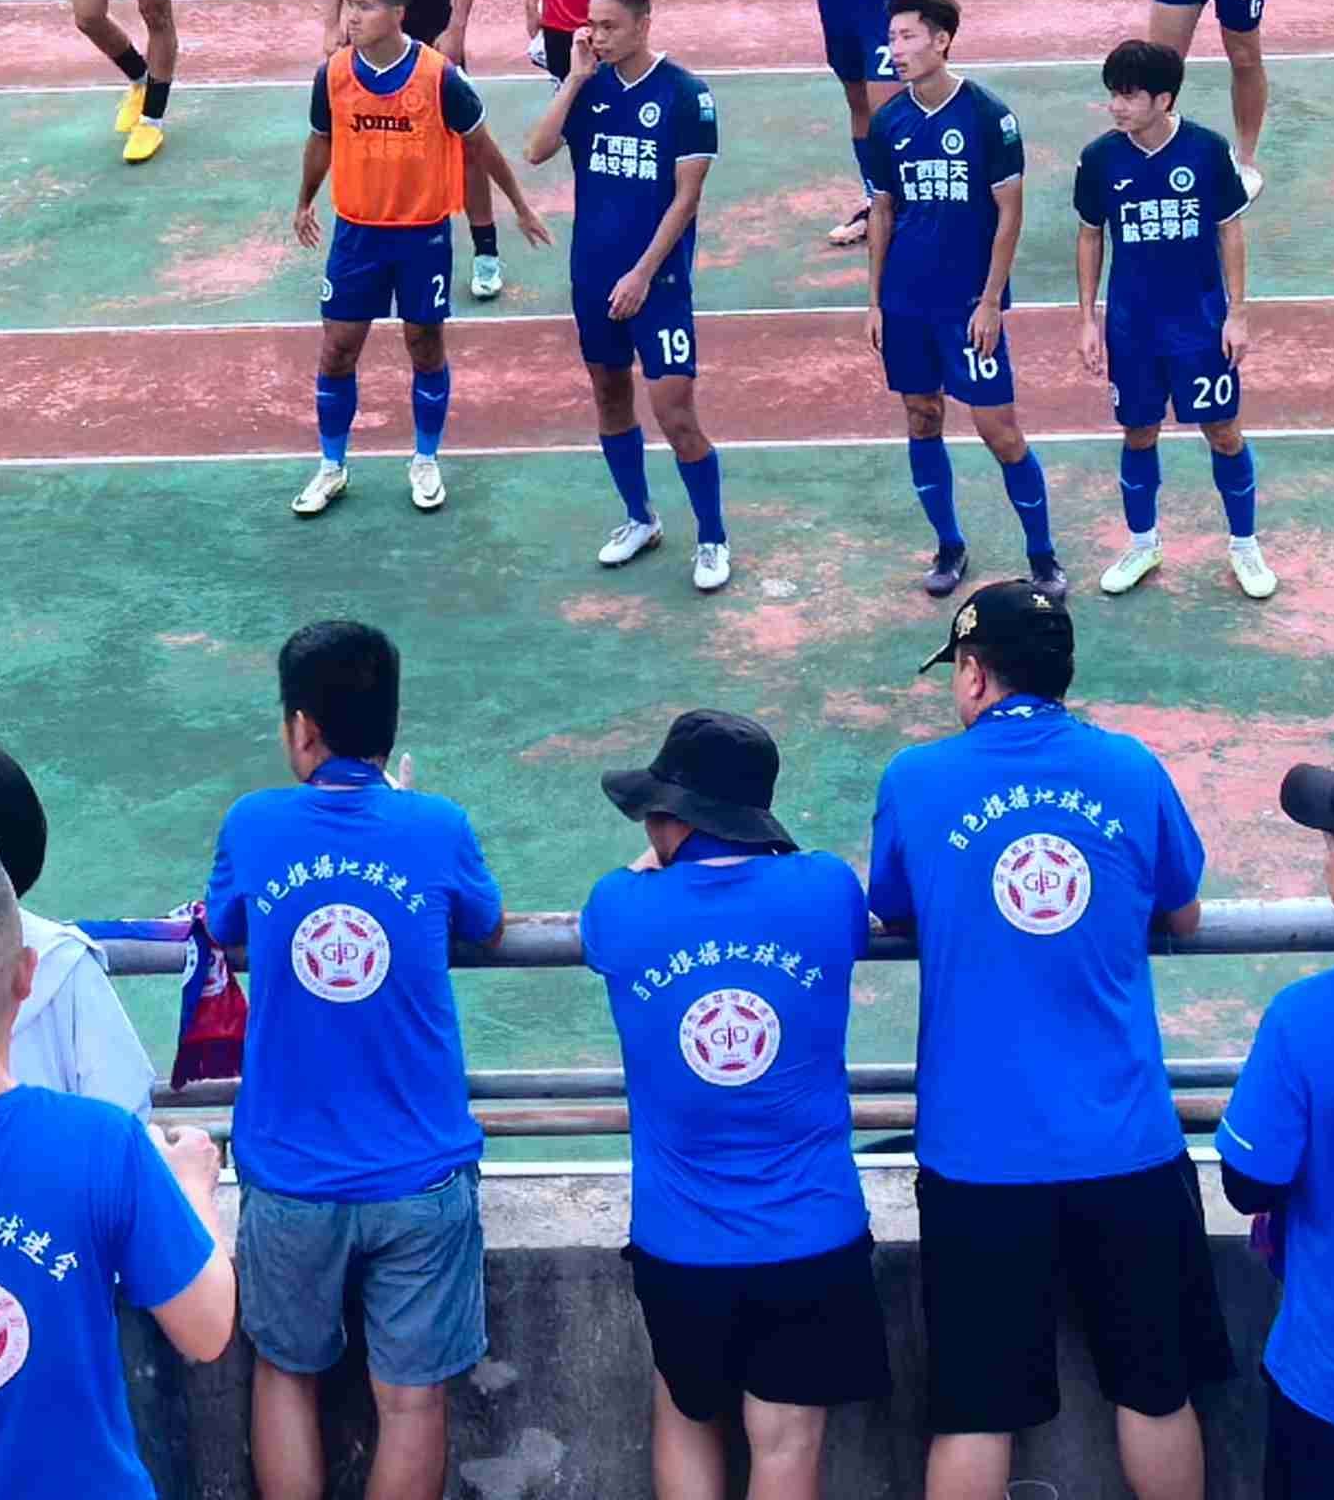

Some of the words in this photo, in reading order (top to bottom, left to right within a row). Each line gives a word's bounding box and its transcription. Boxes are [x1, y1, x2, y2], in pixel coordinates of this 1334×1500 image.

[431, 274, 446, 308] 2
[657, 328, 690, 365] 19
[963, 348, 999, 382] 16
[1193, 374, 1233, 409] 20
